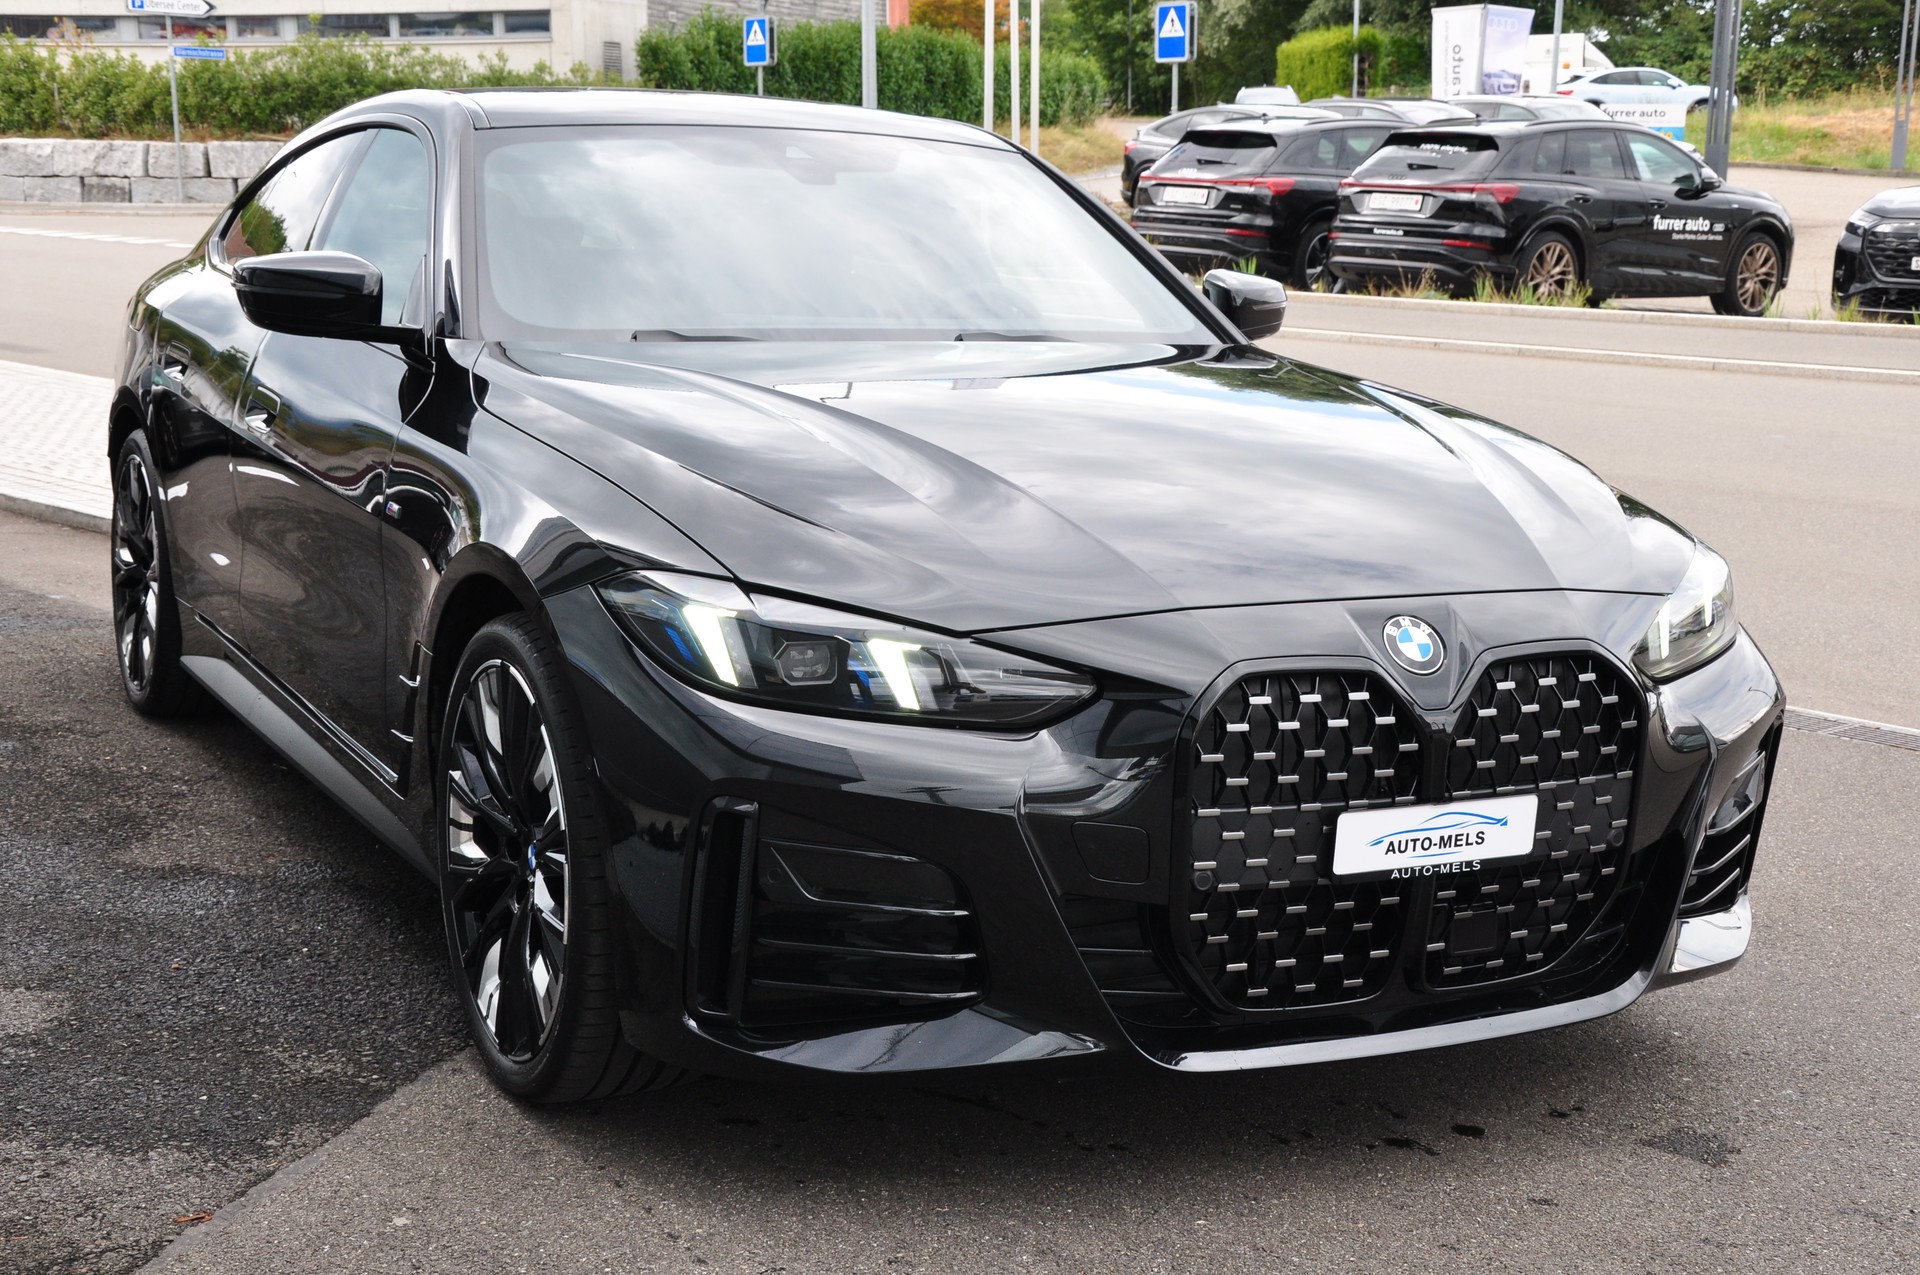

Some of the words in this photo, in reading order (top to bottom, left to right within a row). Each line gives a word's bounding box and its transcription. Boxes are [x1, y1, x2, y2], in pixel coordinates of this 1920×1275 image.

[177, 0, 201, 11] Center
[1452, 44, 1464, 86] auto
[1639, 109, 1666, 118] auto
[1653, 214, 1685, 231] furrer
[1685, 216, 1710, 232] auto
[1386, 617, 1432, 636] BMW
[1384, 831, 1485, 856] AUTO-MELS
[1390, 859, 1481, 880] AUTO-MELS
